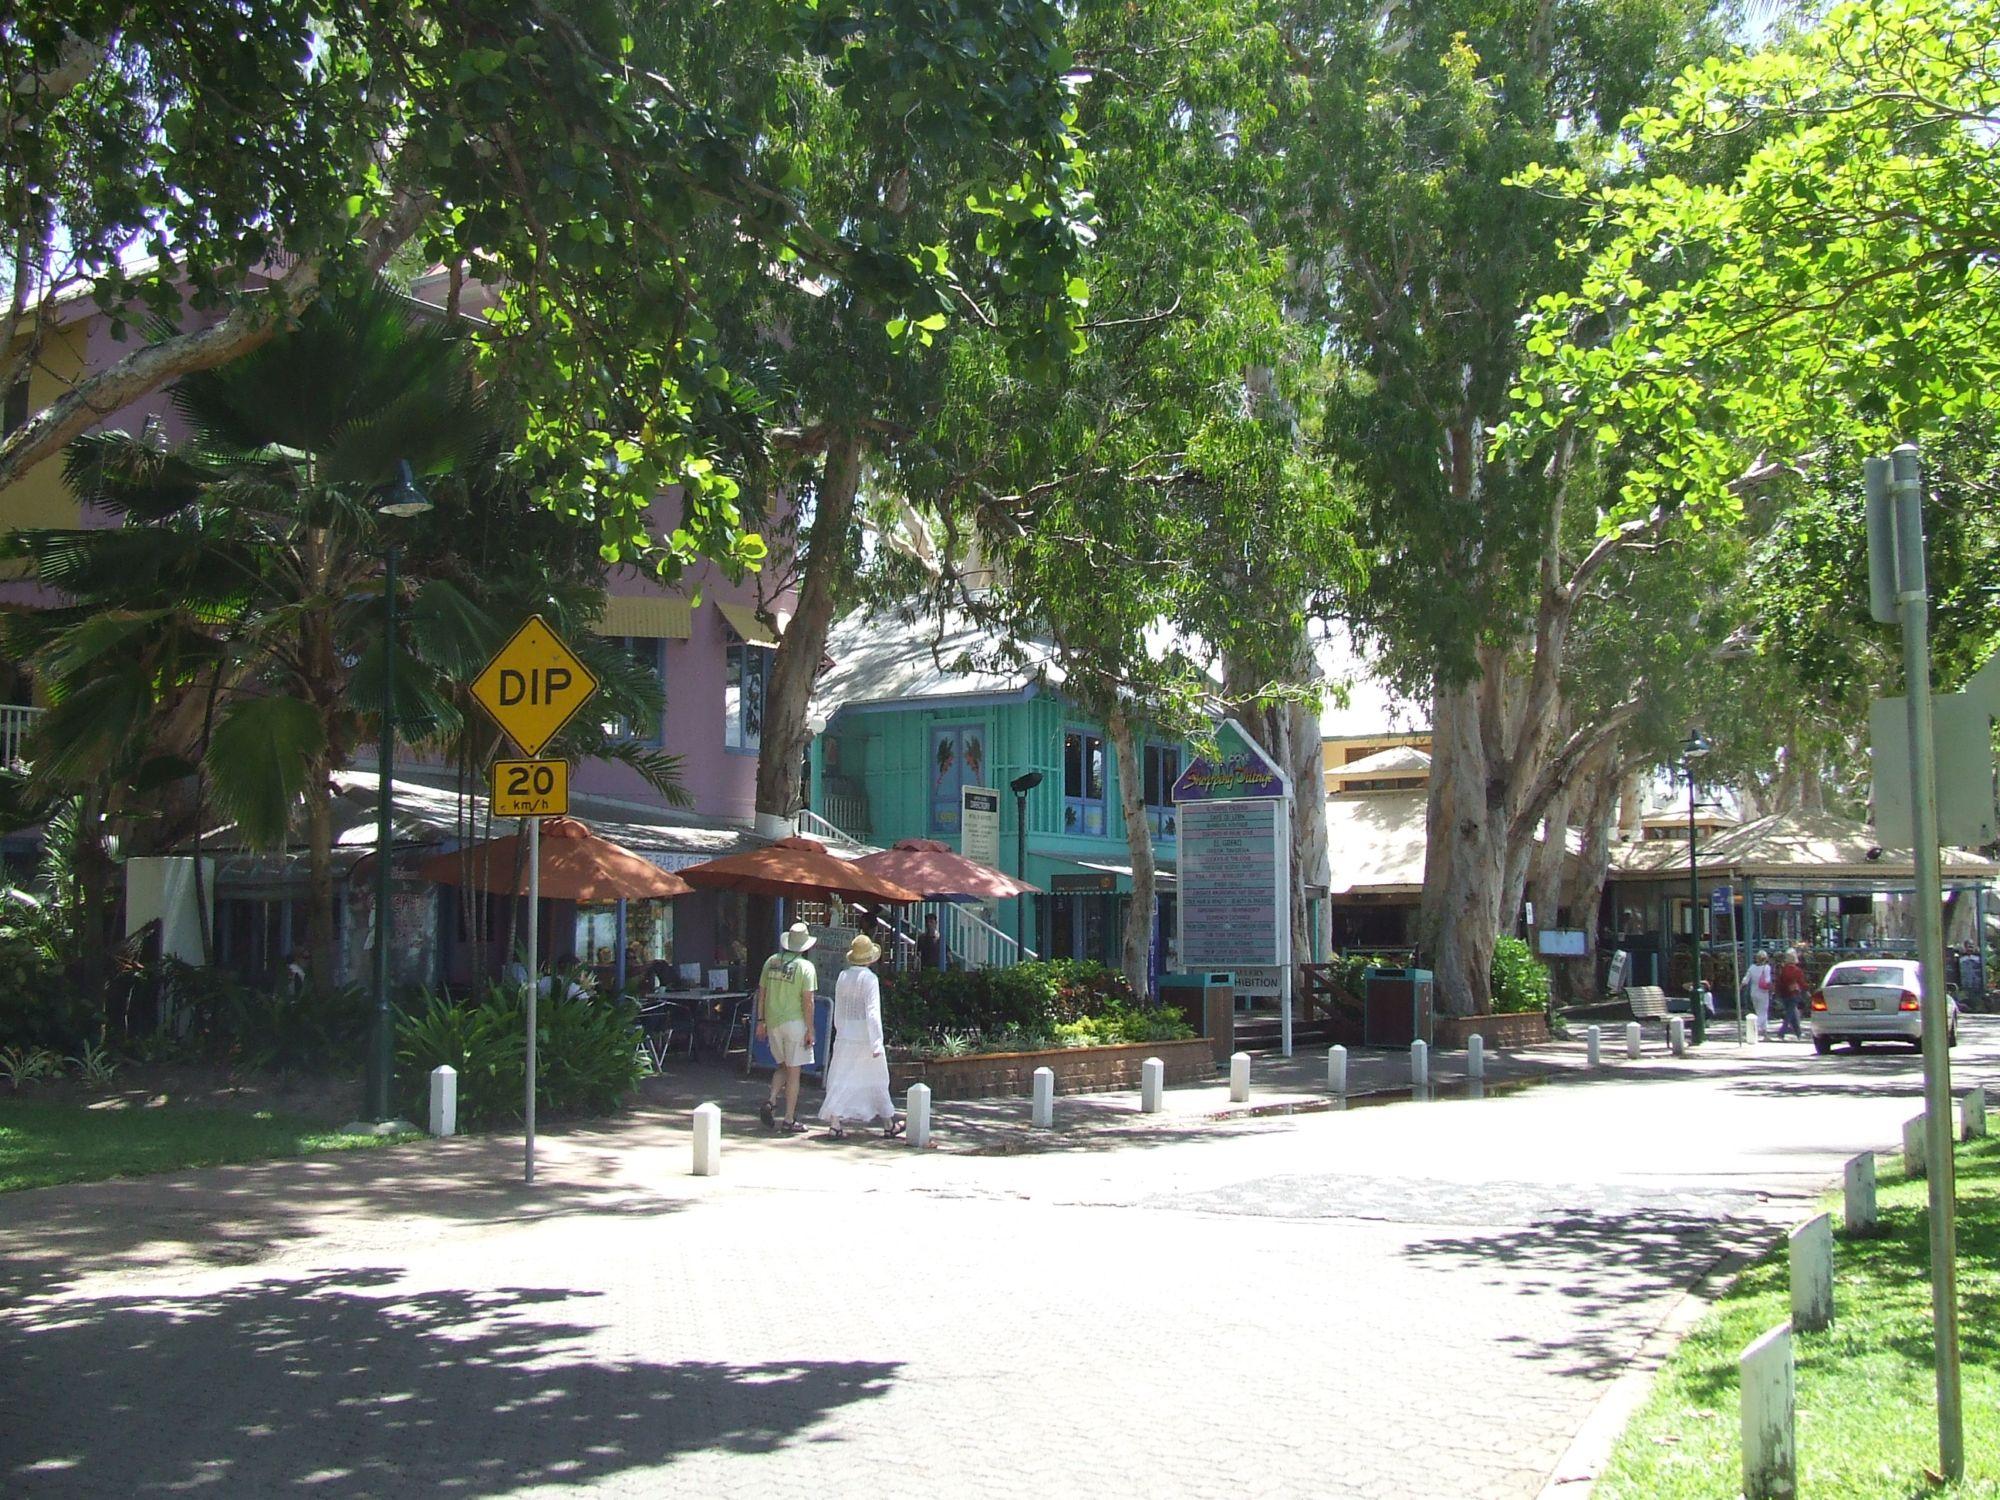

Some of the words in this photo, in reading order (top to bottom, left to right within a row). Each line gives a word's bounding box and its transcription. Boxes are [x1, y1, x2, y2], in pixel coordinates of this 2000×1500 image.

[499, 667, 573, 707] DIP
[507, 766, 554, 796] 20
[1182, 771, 1233, 791] Shopping
[1234, 768, 1273, 788] Village
[513, 799, 549, 812] km/h
[1234, 977, 1278, 988] HIBITION
